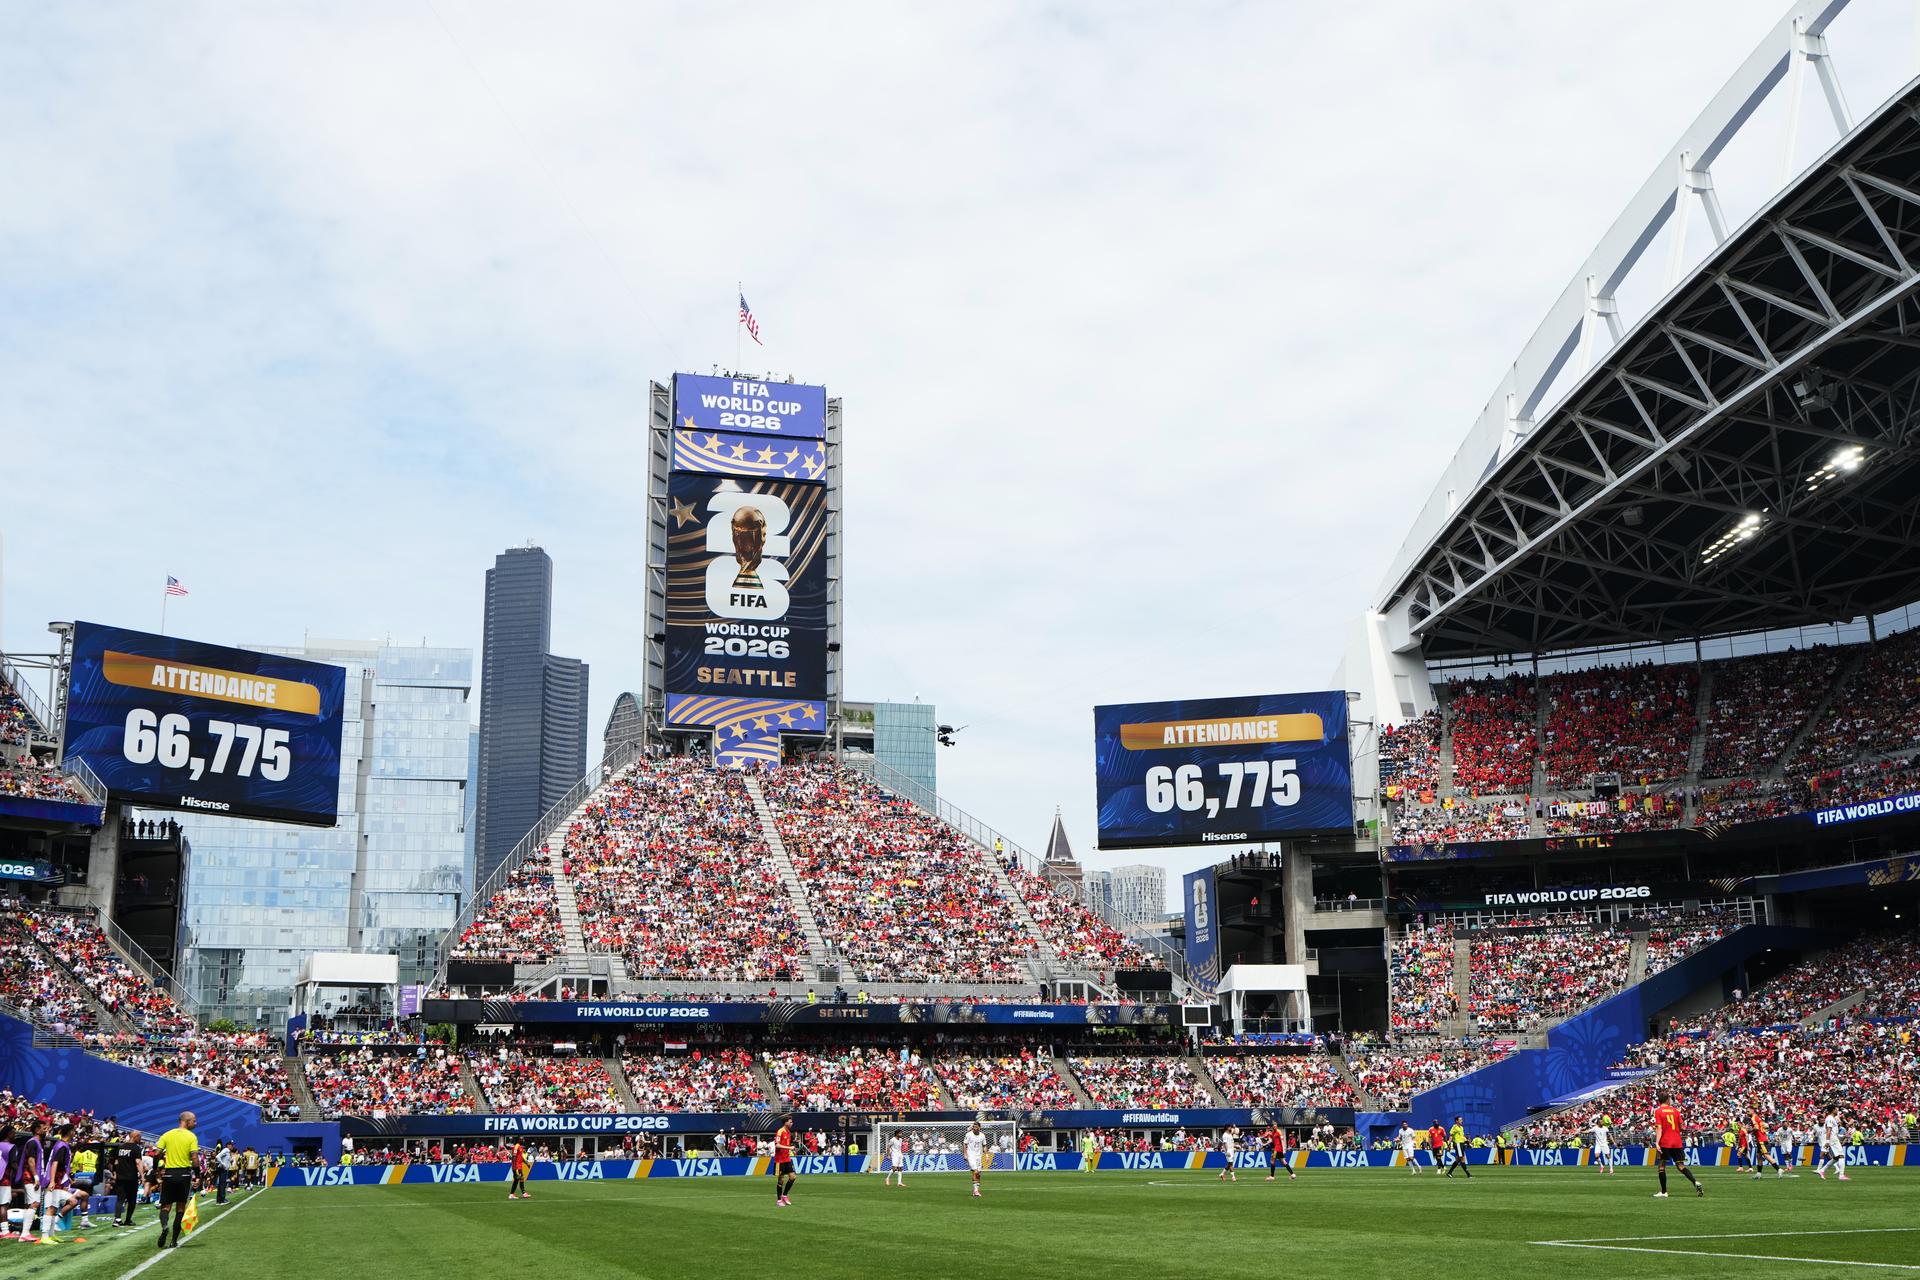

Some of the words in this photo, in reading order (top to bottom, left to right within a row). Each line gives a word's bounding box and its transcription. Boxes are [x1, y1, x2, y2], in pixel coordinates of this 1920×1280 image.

[732, 381, 770, 398] FIFA
[701, 394, 765, 413] WORLD
[767, 400, 802, 416] CUP
[719, 412, 782, 431] 2026
[730, 593, 768, 609] FIFA
[704, 622, 759, 637] WORLD
[760, 625, 790, 638] CUP
[704, 636, 790, 659] 2026
[151, 664, 277, 704] ATTENDANCE
[697, 666, 797, 688] SEATTLE
[31, 733, 59, 745] 344
[1163, 720, 1279, 745] ATTENDANCE
[123, 708, 292, 782] 66,775
[1145, 759, 1301, 820] 66,775
[180, 795, 230, 812] Hisense
[1816, 808, 1845, 825] FIFA
[1845, 800, 1894, 820] WORLD
[1202, 831, 1248, 842] Hisense
[1545, 836, 1616, 852] SETTLE
[0, 863, 35, 876] 026
[1485, 893, 1516, 905] FIFA
[1516, 890, 1568, 904] WORLD
[1569, 889, 1598, 901] CUP
[1600, 886, 1651, 900] 2026
[577, 1007, 602, 1017] FIFA
[603, 1007, 645, 1018] WORLD
[645, 1007, 669, 1017] CUP
[669, 1007, 709, 1018] 2026
[819, 1008, 869, 1018] SEATTLE
[1013, 1010, 1055, 1019] #FIFAWorldCup
[484, 1117, 519, 1131] FIFA
[521, 1117, 579, 1131] WORLD
[581, 1116, 612, 1130] CUP
[614, 1116, 669, 1130] 2026
[1122, 1113, 1179, 1124] #FIFAWorldCup
[1666, 1114, 1676, 1131] 4
[791, 1156, 838, 1174] VISA
[902, 1154, 949, 1171] VISA
[1016, 1153, 1057, 1170] VISA
[1117, 1152, 1164, 1169] VISA
[1325, 1150, 1369, 1167] VISA
[1526, 1149, 1563, 1166] VISA
[299, 1166, 354, 1186] VISA
[426, 1163, 481, 1183] VISA
[551, 1161, 604, 1180] VISA
[672, 1158, 723, 1177] VISA
